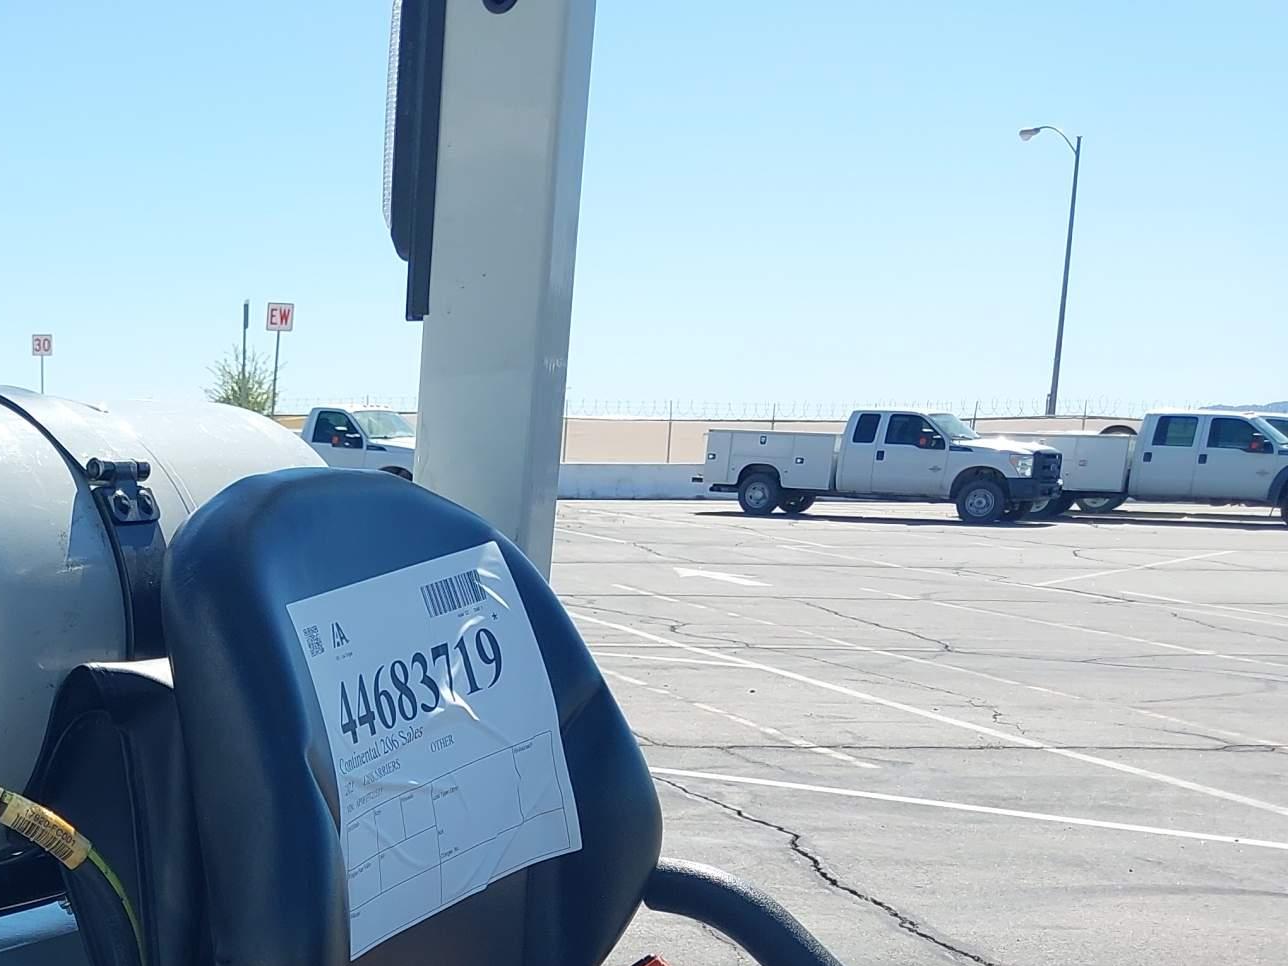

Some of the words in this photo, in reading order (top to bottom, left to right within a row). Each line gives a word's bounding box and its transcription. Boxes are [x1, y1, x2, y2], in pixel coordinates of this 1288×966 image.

[269, 307, 292, 326] EW
[33, 338, 52, 352] 30
[339, 627, 502, 744] 44683719
[339, 743, 381, 775] Continental
[380, 734, 400, 755] 206
[398, 725, 424, 746] Sales
[430, 734, 455, 752] OTHER
